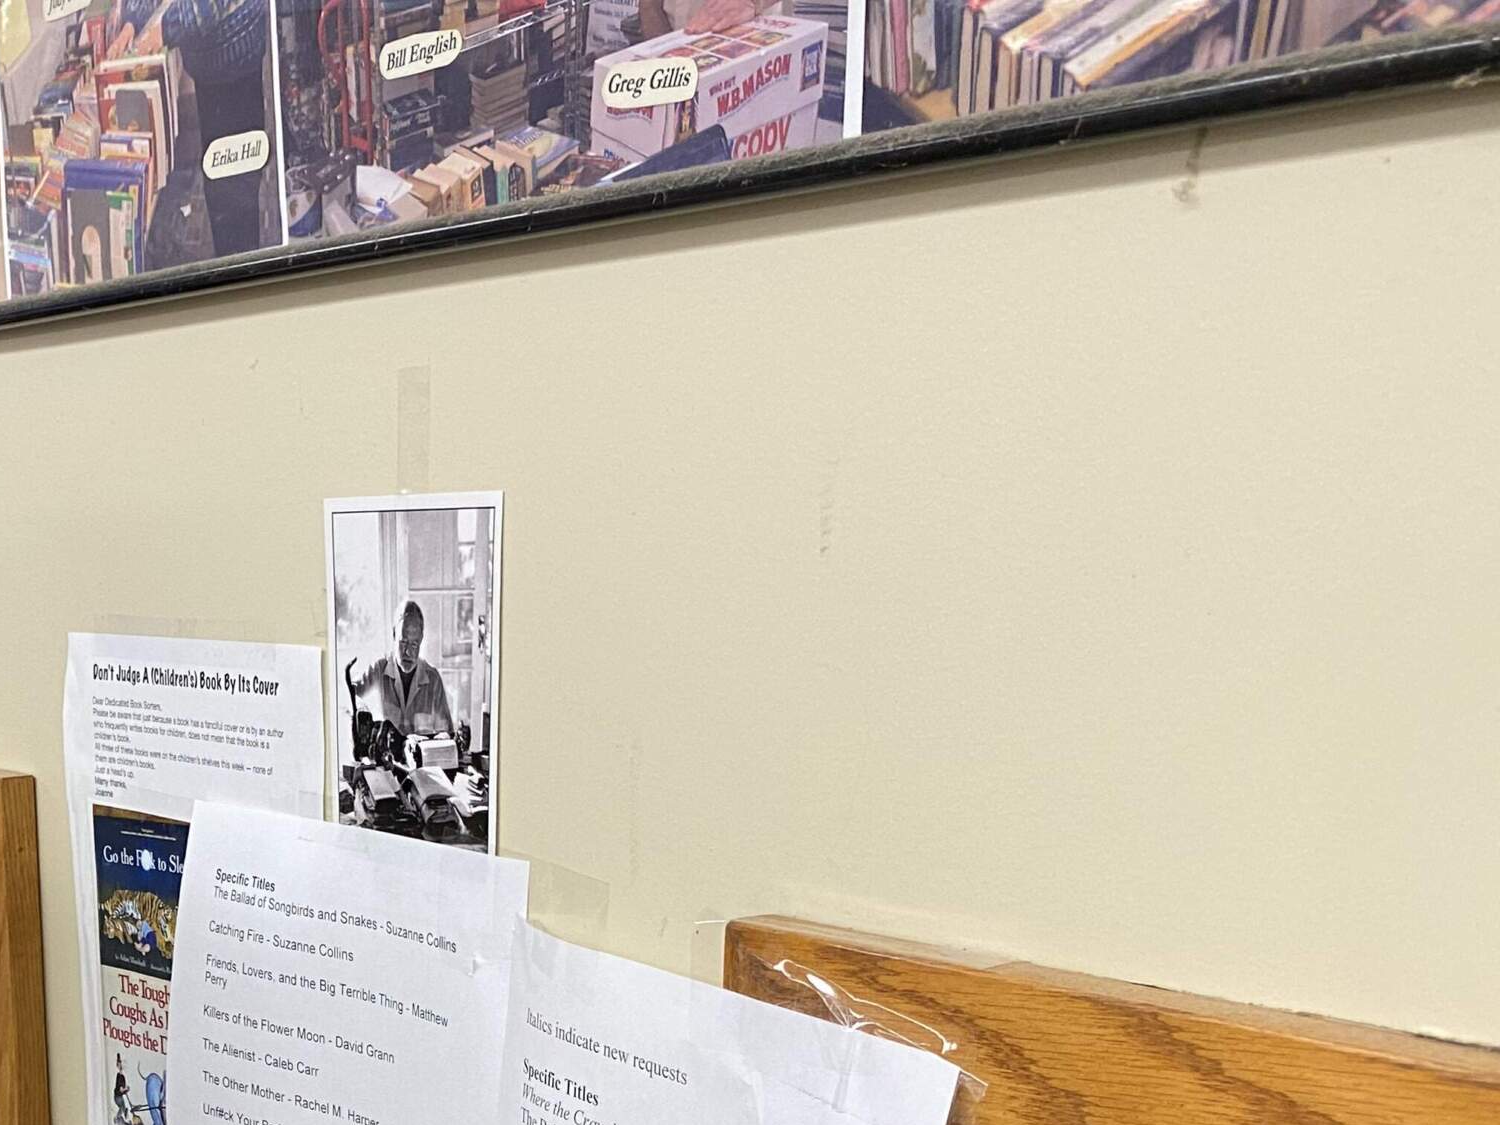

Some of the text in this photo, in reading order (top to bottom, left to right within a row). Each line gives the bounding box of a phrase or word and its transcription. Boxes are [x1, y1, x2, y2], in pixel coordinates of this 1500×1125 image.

[386, 33, 457, 70] Bill English
[608, 73, 646, 98] Greg
[650, 67, 691, 90] Gillis
[211, 140, 262, 168] Erika Hall
[93, 663, 279, 697] Don't Judge A (Children's) Book By Its Cover
[103, 845, 119, 864] Go
[121, 848, 134, 866] the
[137, 849, 156, 871] Fk
[158, 857, 167, 872] to
[216, 868, 276, 892] Specific Titles
[213, 886, 456, 952] The Ballad of Songbirds and Snakes Suzanne Collins
[208, 920, 354, 962] Catching Fire Suzanne Collins
[118, 973, 139, 997] The
[204, 972, 228, 990] Perry
[206, 954, 448, 1027] Friends, Lovers, and the Big Terrible Thing Matthew
[109, 995, 164, 1029] Coughs As
[103, 1017, 159, 1052] Ploughs the
[203, 1004, 395, 1064] Killers of the Flower Moon David Grann
[526, 1007, 688, 1086] Italics indicate new requests
[202, 1038, 319, 1078] The Alienist Caleb Carr
[522, 1057, 600, 1107] Specific Titles
[521, 1083, 552, 1111] Where
[552, 1102, 571, 1121] the
